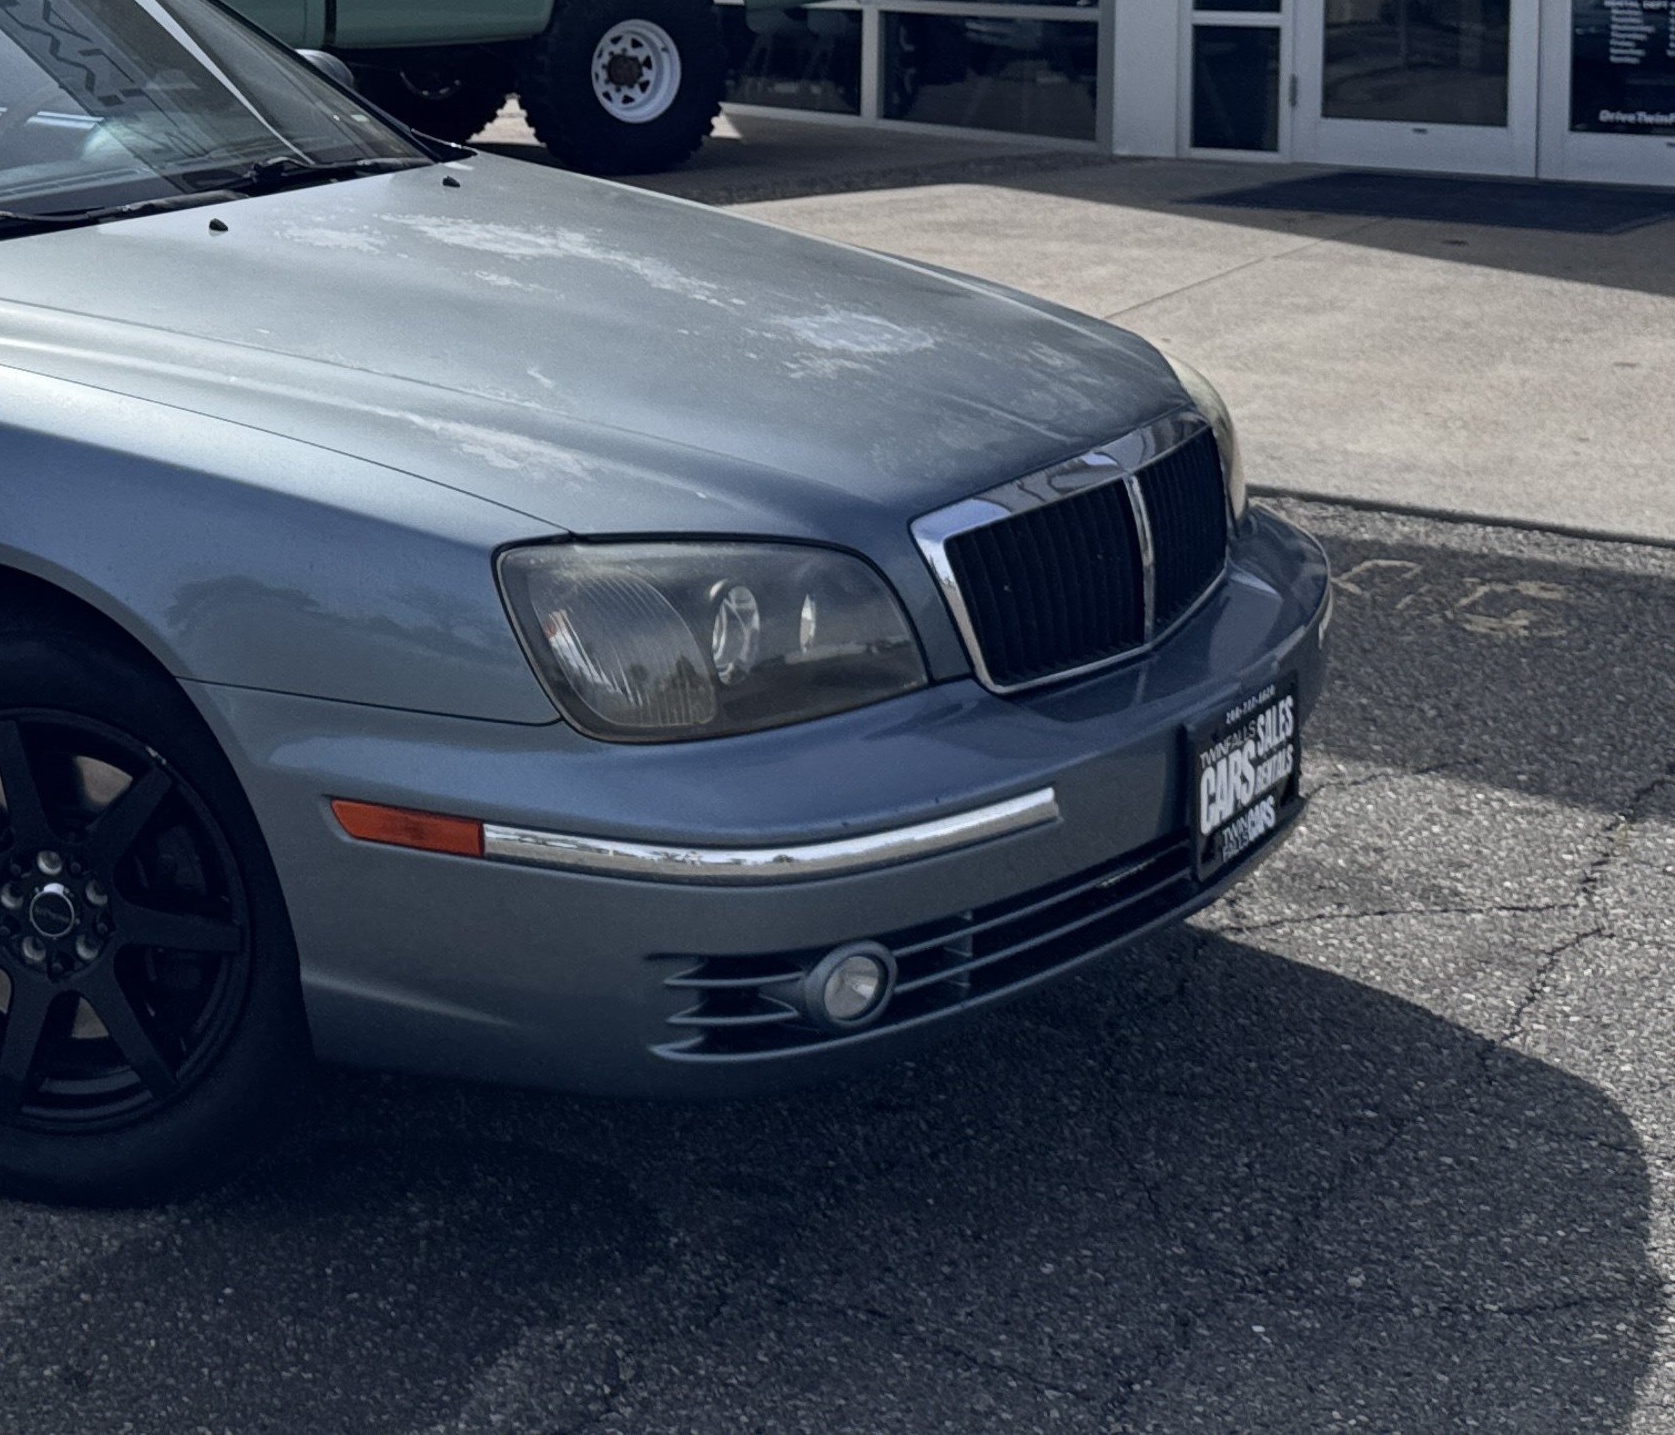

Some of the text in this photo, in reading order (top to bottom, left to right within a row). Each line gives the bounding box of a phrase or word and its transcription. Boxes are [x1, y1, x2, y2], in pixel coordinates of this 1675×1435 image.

[1256, 694, 1294, 756] SALES
[1200, 738, 1294, 836] CARS RENTALS
